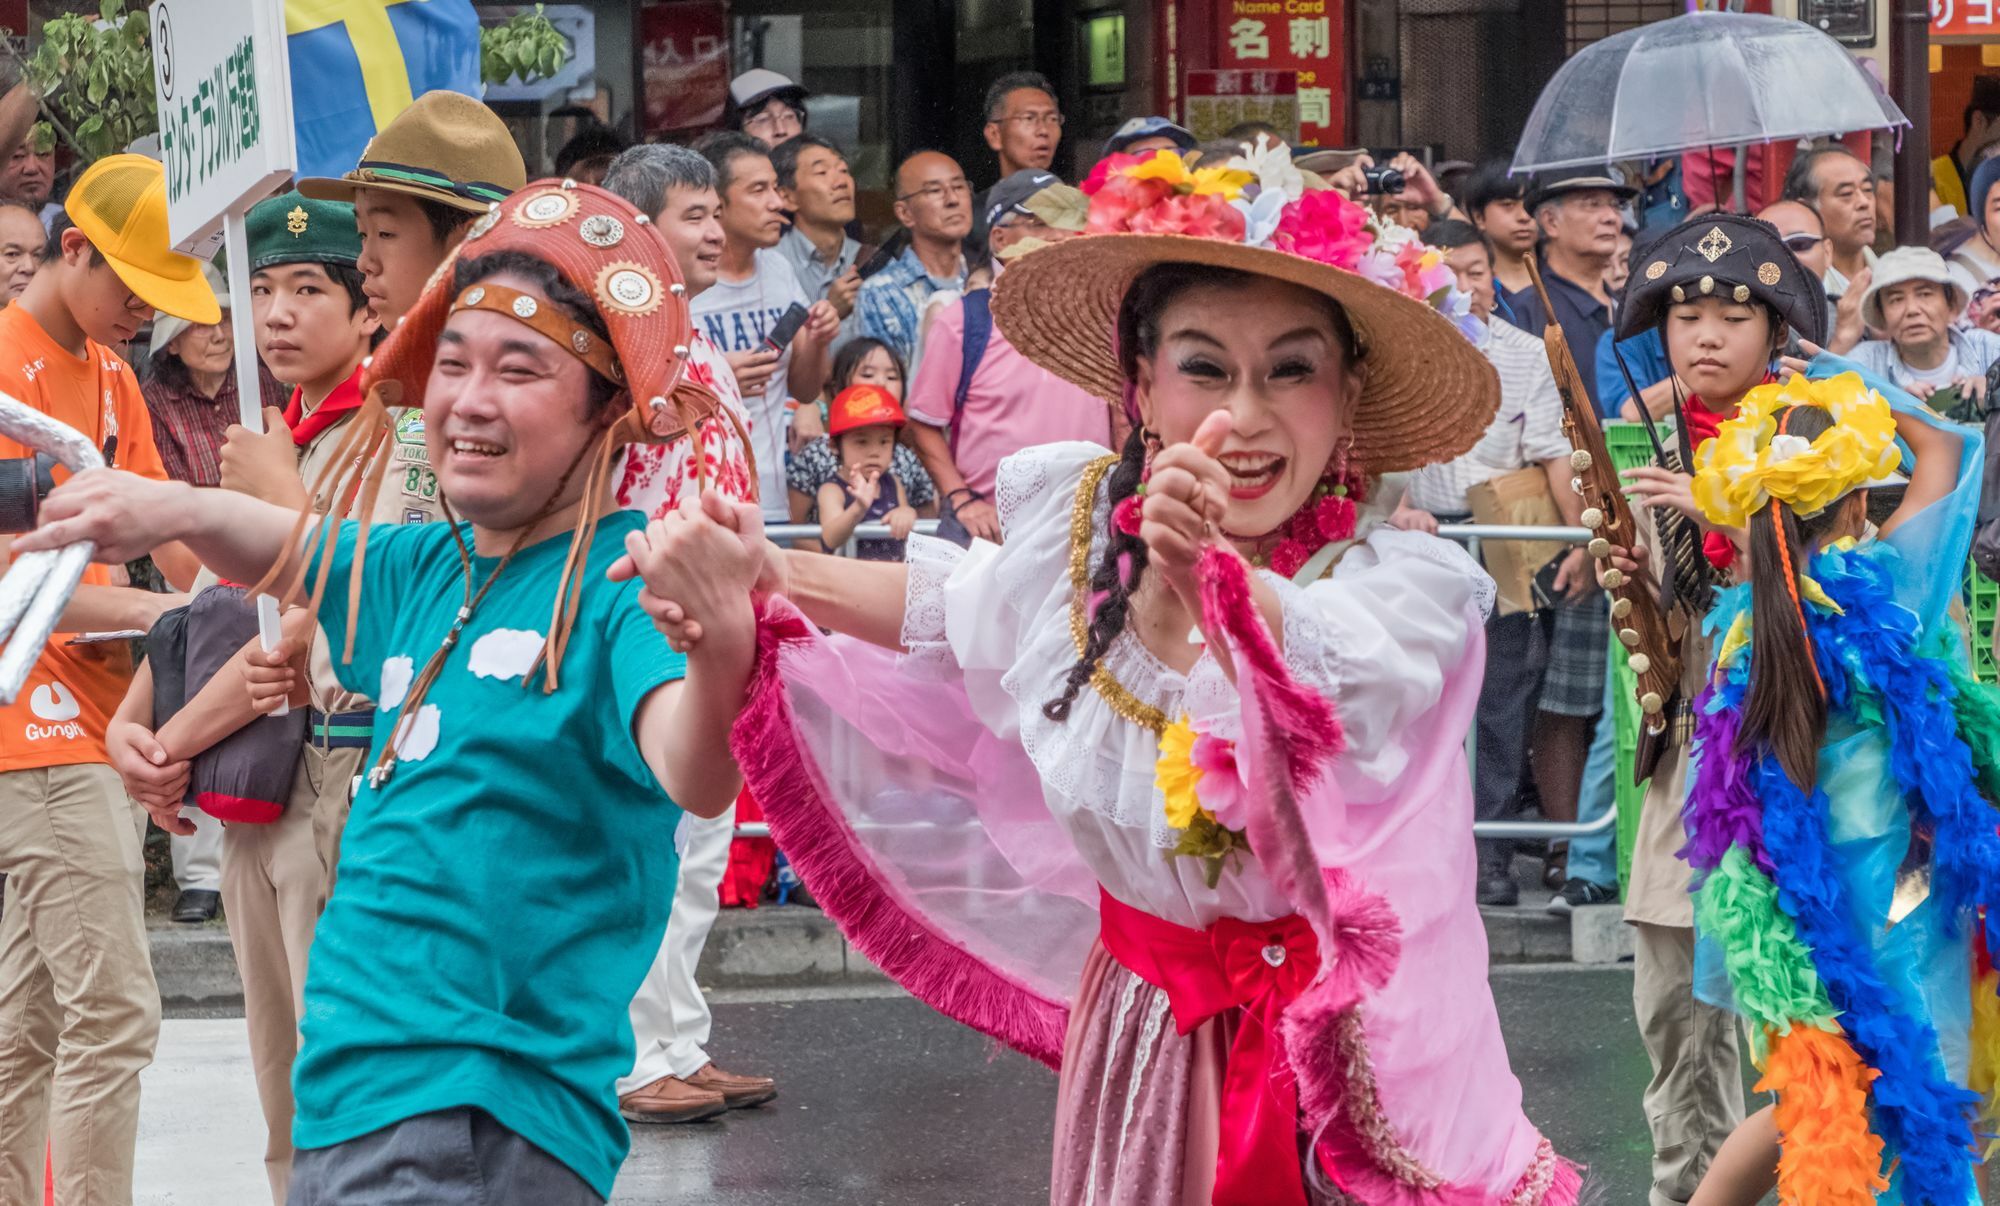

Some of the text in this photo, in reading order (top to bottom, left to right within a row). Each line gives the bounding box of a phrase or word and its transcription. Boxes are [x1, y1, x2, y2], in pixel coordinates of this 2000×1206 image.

[1233, 0, 1325, 14] Name Card
[1229, 17, 1330, 59] 名刺
[406, 467, 437, 497] 83
